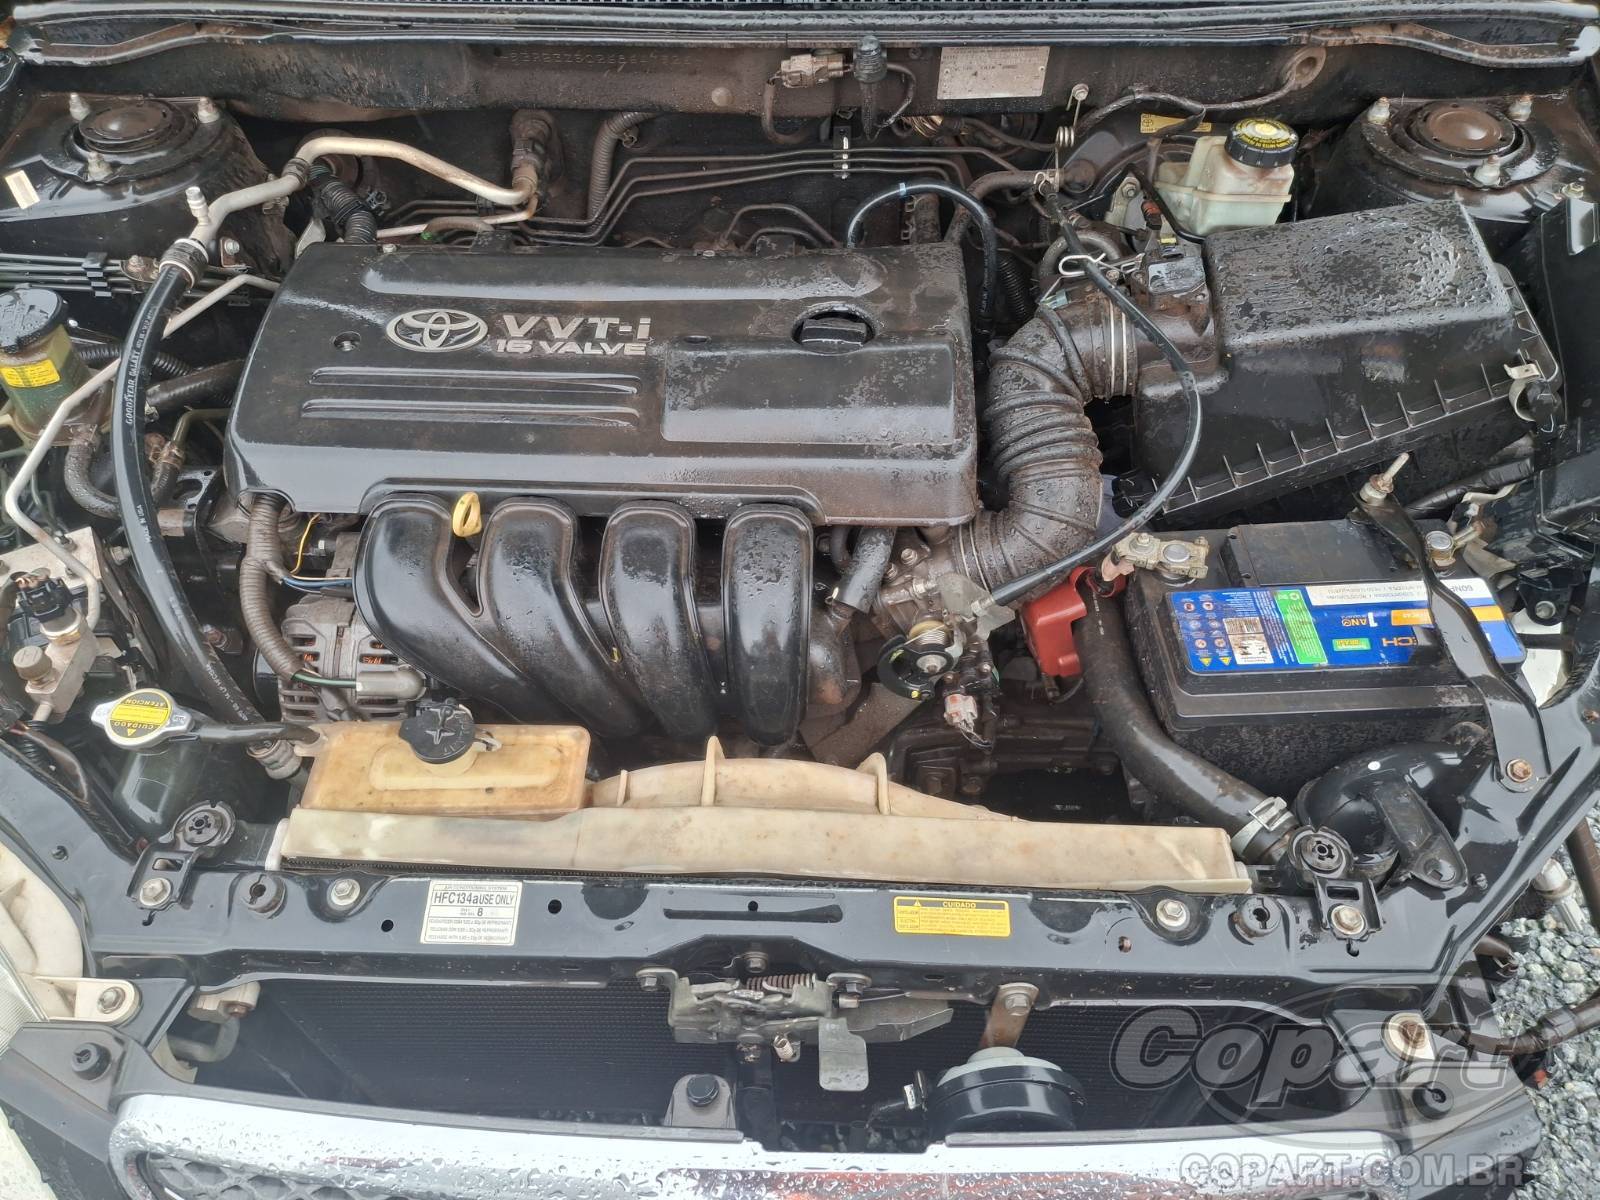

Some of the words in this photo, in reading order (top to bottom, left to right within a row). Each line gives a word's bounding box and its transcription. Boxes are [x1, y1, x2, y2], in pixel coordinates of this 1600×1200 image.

[503, 314, 652, 339] VVT-i
[496, 339, 534, 354] 16
[539, 341, 647, 356] VALVE
[124, 380, 137, 425] GOODYEAR
[1367, 612, 1379, 628] 1
[113, 721, 155, 731] CUIDADO
[433, 891, 479, 905] HFC134a
[479, 893, 494, 905] USE
[495, 893, 515, 905] ONLY
[476, 907, 484, 917] 8
